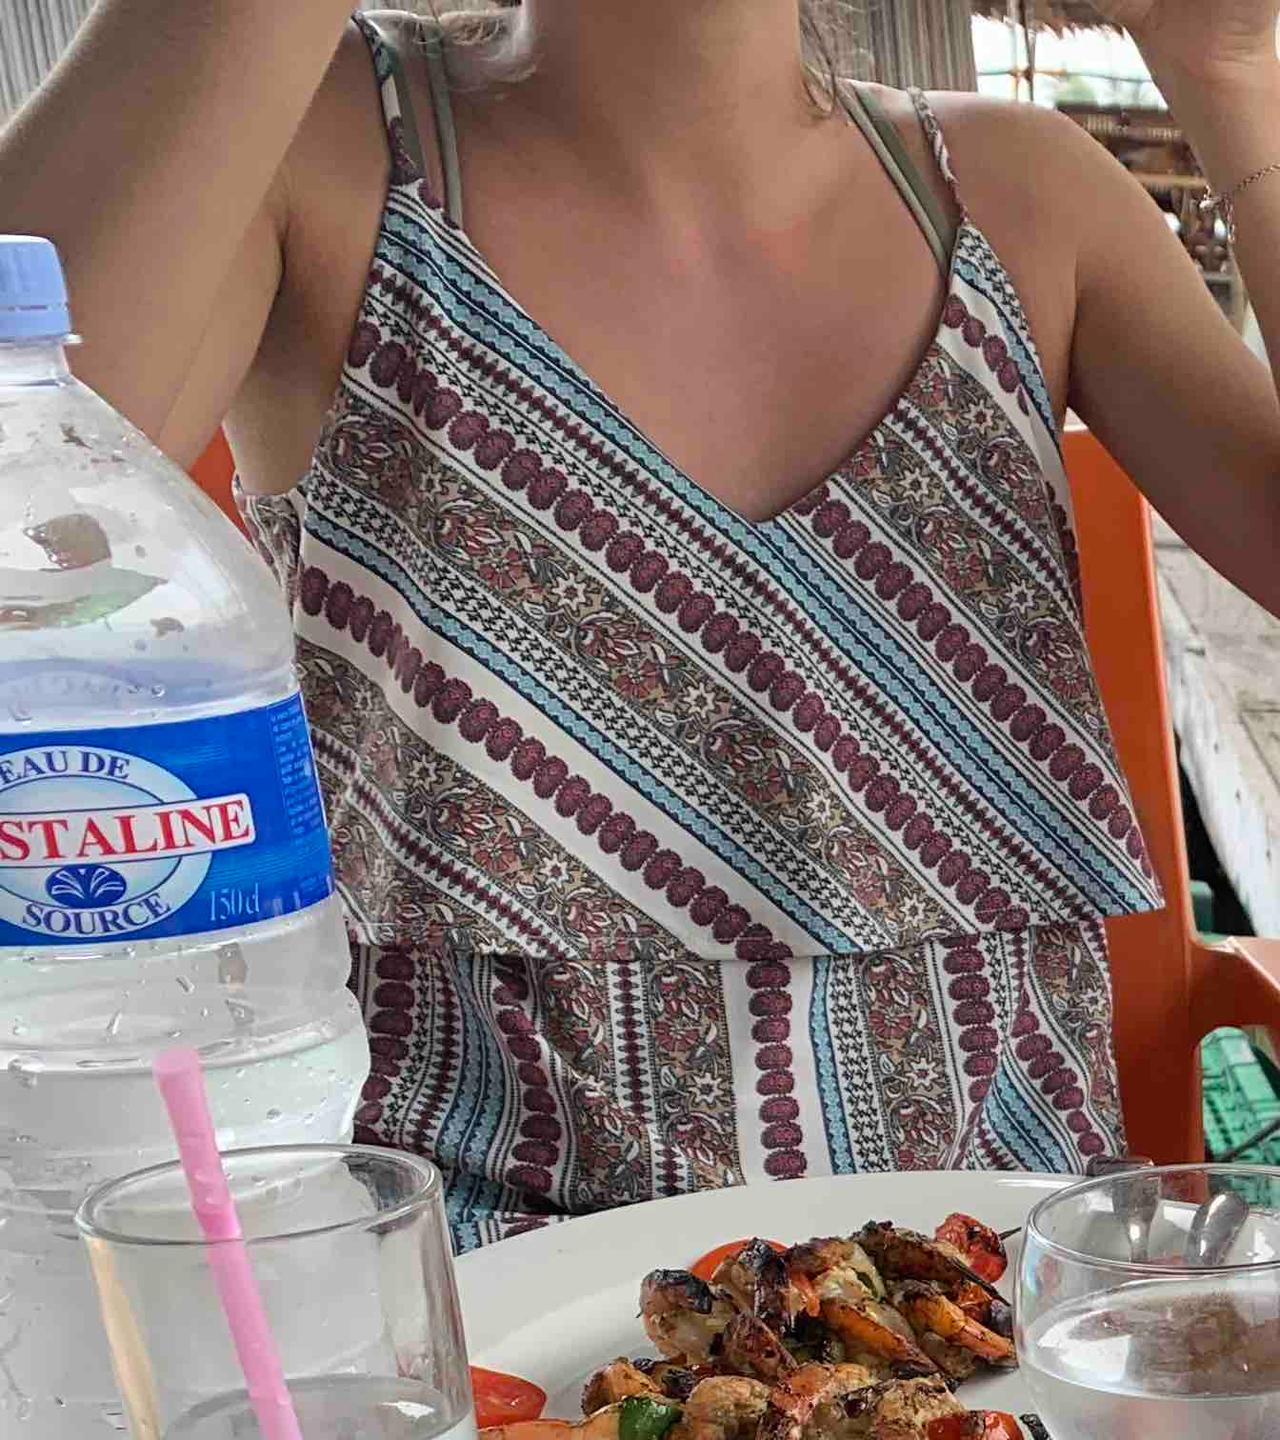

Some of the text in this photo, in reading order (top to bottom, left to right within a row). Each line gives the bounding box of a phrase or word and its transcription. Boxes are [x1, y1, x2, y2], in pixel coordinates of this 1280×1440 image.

[0, 751, 130, 784] EAU DE
[22, 892, 170, 935] SOURCE
